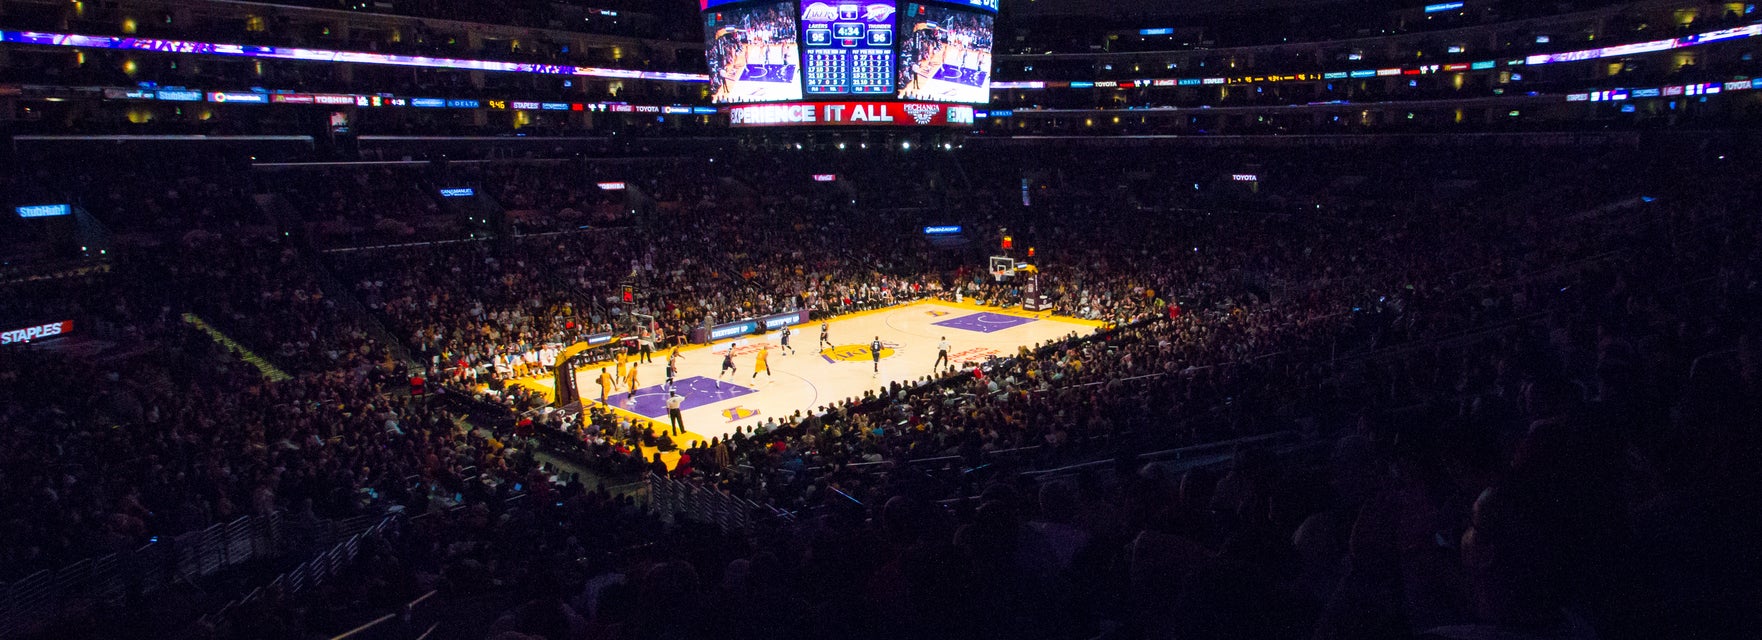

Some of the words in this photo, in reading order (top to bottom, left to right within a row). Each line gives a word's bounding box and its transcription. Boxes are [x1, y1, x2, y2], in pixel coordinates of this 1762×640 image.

[838, 27, 859, 36] 4:34
[812, 34, 824, 42] 95
[873, 34, 886, 42] 96
[1725, 81, 1751, 91] TOYOTA
[127, 90, 154, 98] verion
[315, 96, 354, 104] TOSHIBA
[904, 104, 939, 112] PECHANGA
[731, 104, 816, 124] EXPERIENCE
[824, 105, 845, 122] IT
[850, 105, 893, 122] ALL
[20, 204, 65, 217] StubHub!
[1, 322, 62, 344] STAPLES
[712, 327, 740, 338] EVERYBODY
